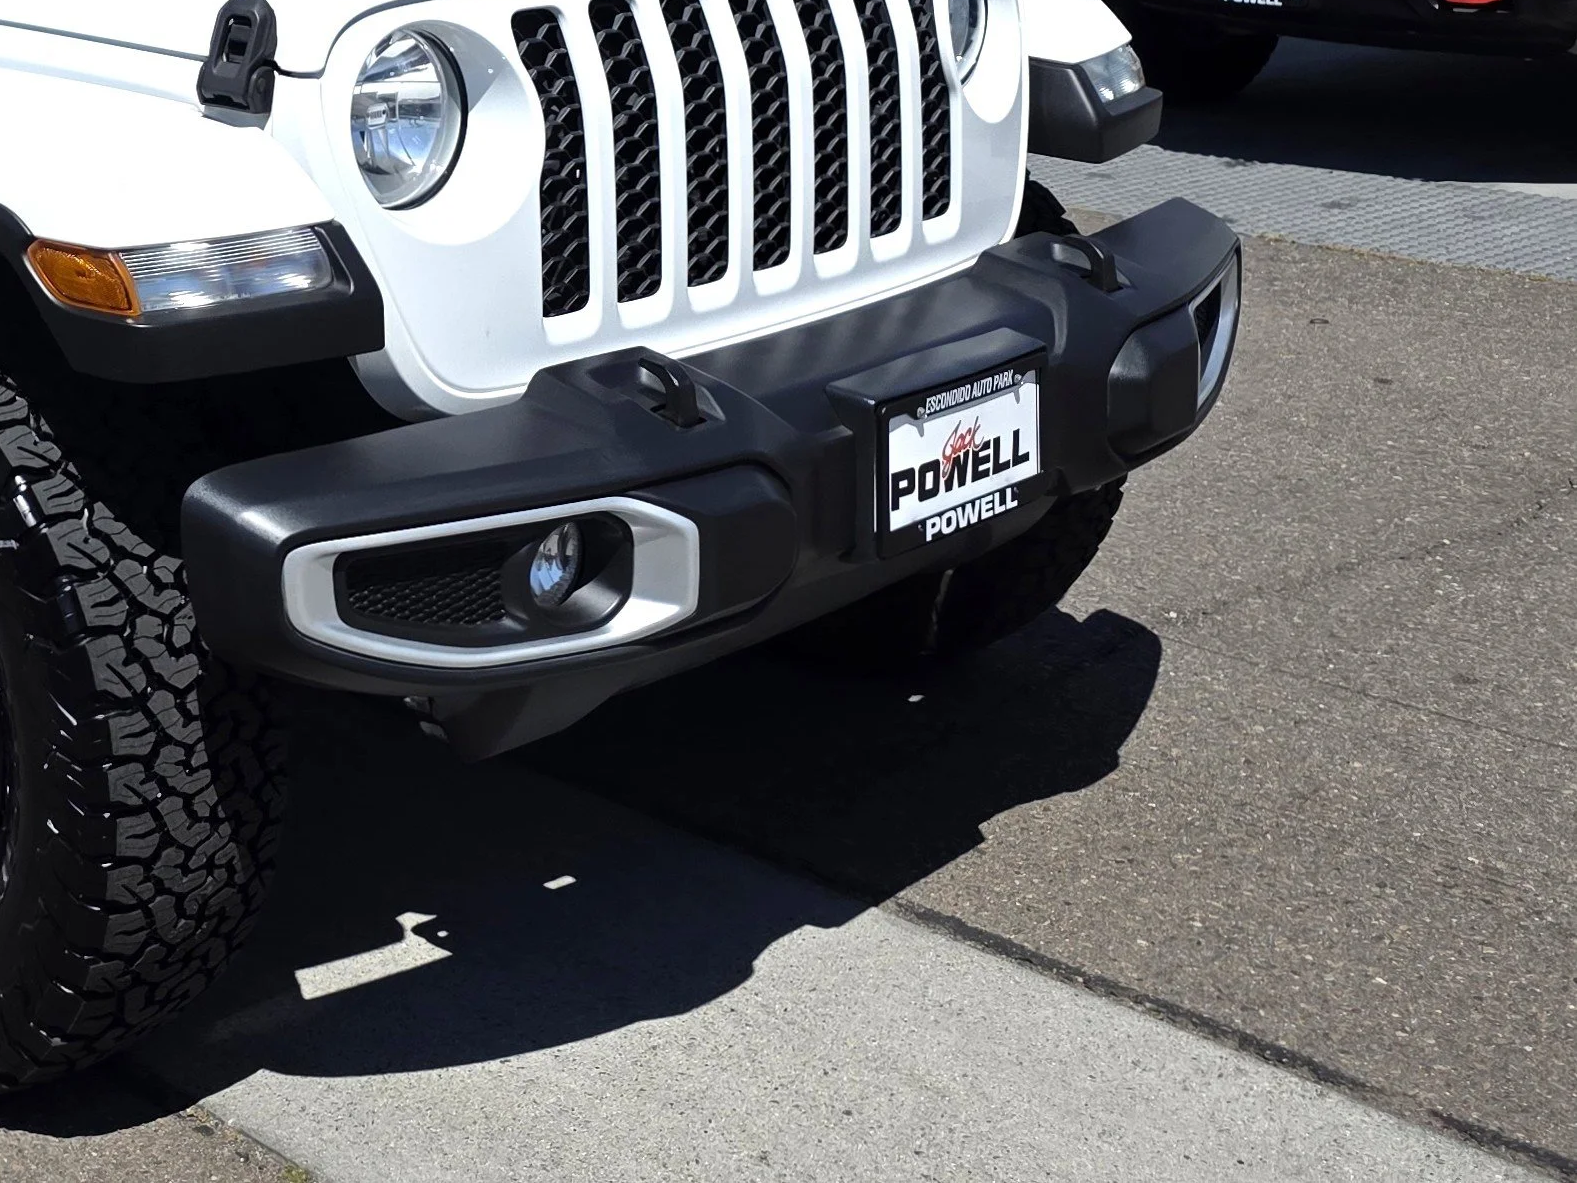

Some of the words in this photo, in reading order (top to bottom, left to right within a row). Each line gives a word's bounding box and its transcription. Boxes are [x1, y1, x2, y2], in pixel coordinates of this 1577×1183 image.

[925, 384, 972, 414] ESCONDIDO
[971, 376, 993, 398] AUTO
[993, 369, 1014, 391] PARK
[890, 428, 1030, 512] POWELL
[942, 416, 984, 478] Jack
[926, 487, 1018, 542] POWELL
